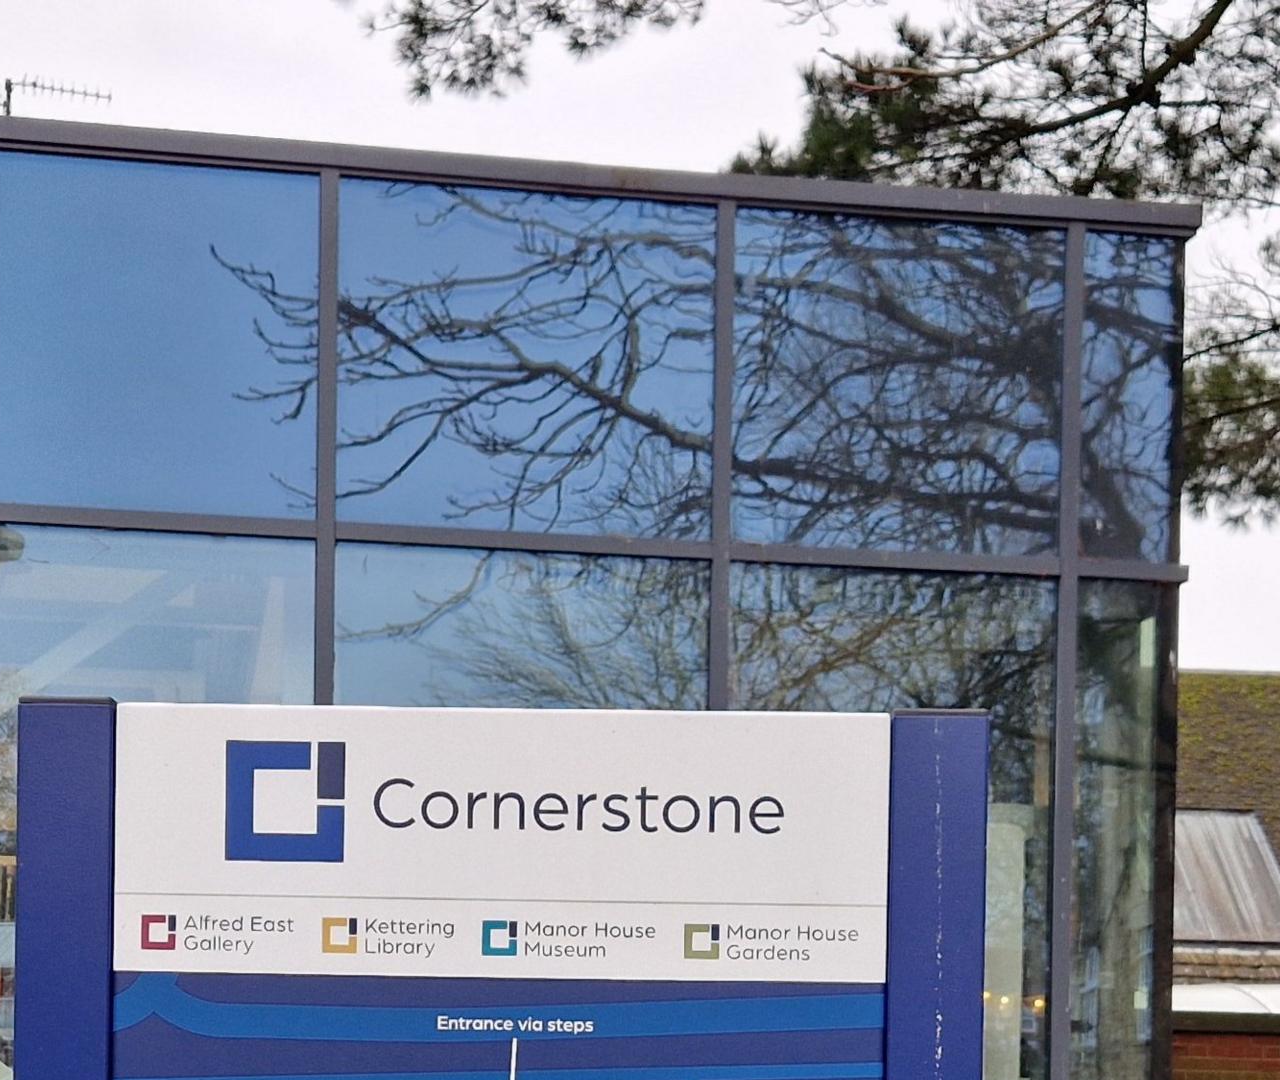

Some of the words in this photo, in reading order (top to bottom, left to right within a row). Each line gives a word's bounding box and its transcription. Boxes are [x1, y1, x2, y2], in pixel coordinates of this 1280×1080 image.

[374, 779, 784, 834] Cornerstone
[184, 916, 243, 931] Alfred
[251, 917, 293, 932] East
[366, 919, 454, 938] Kettering
[525, 922, 587, 937] Manor
[596, 923, 655, 938] House
[728, 925, 789, 940] Manor
[798, 926, 858, 941] House
[184, 935, 253, 955] Gallery
[365, 939, 435, 958] Library
[525, 942, 605, 957] Museum
[727, 945, 810, 960] Gardens
[438, 1016, 517, 1030] Entrance
[521, 1017, 542, 1031] via
[548, 1019, 593, 1034] steps
